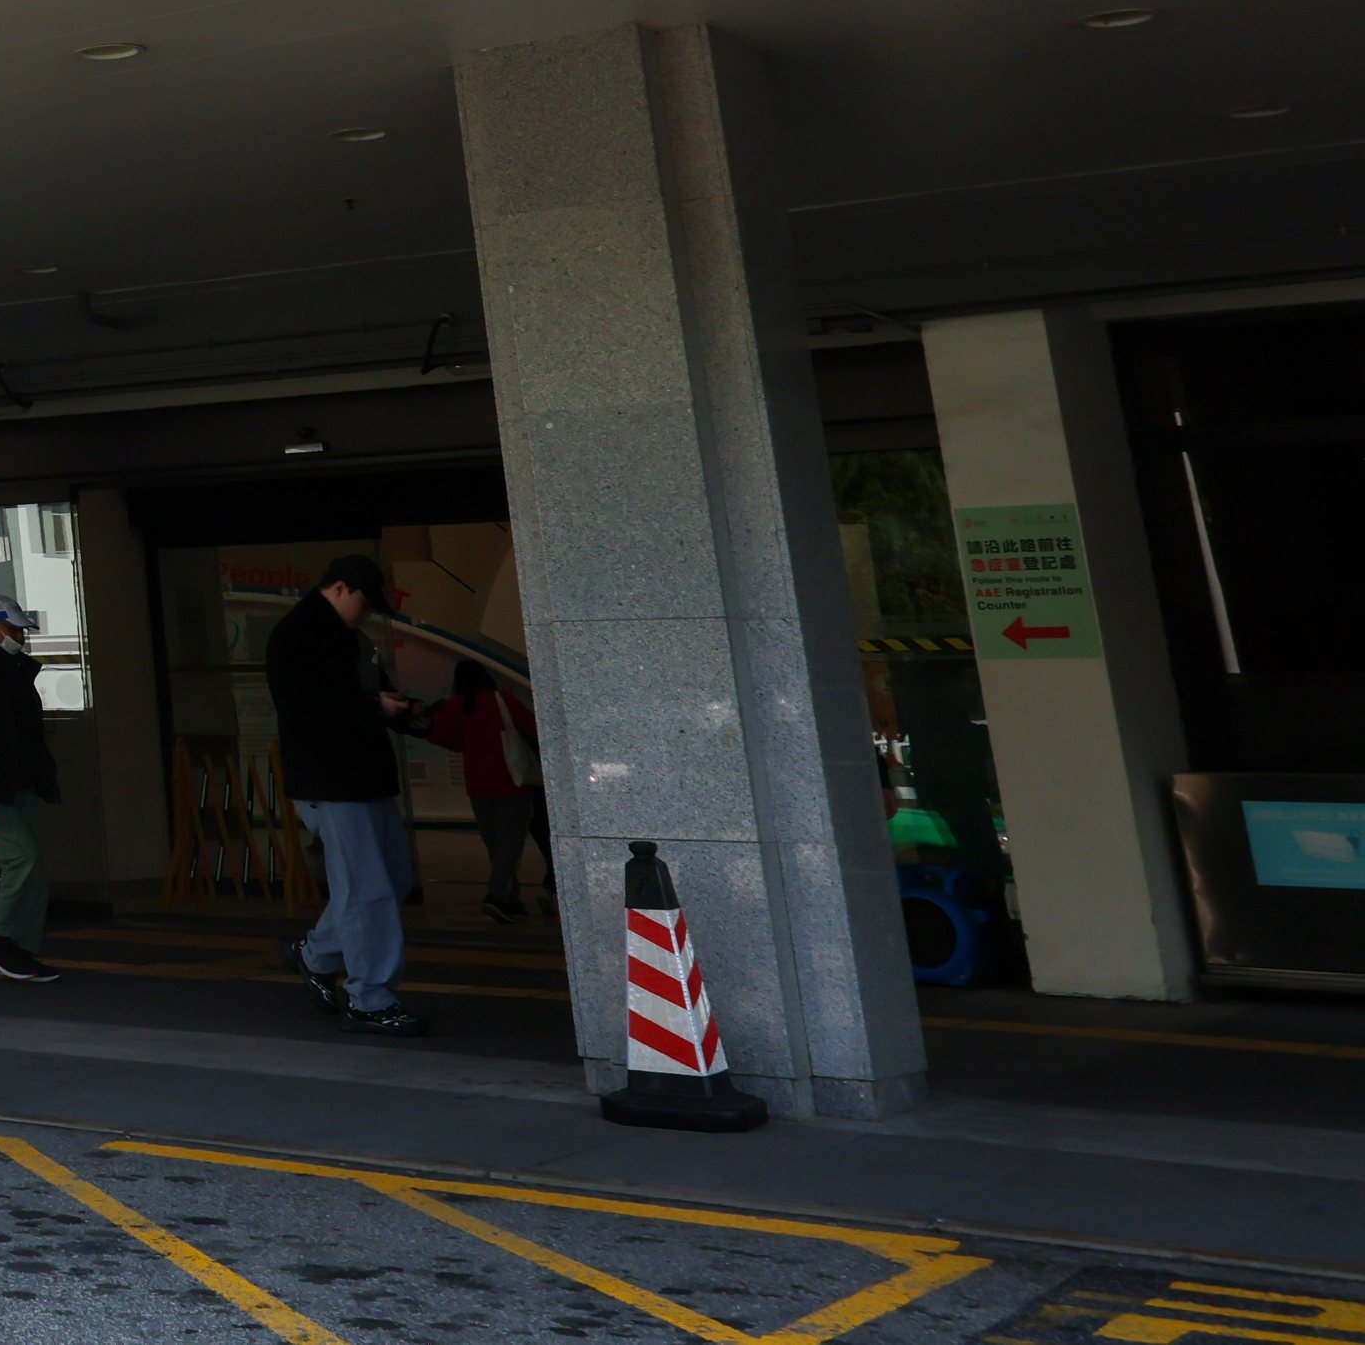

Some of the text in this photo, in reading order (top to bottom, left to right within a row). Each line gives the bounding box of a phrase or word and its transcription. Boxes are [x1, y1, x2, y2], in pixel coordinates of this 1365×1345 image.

[966, 537, 1074, 557] 請沿此路前往
[970, 555, 1077, 573] 急症室登記處
[1052, 575, 1062, 584] to
[975, 586, 1083, 599] A&E Registration
[976, 600, 1027, 612] Counter
